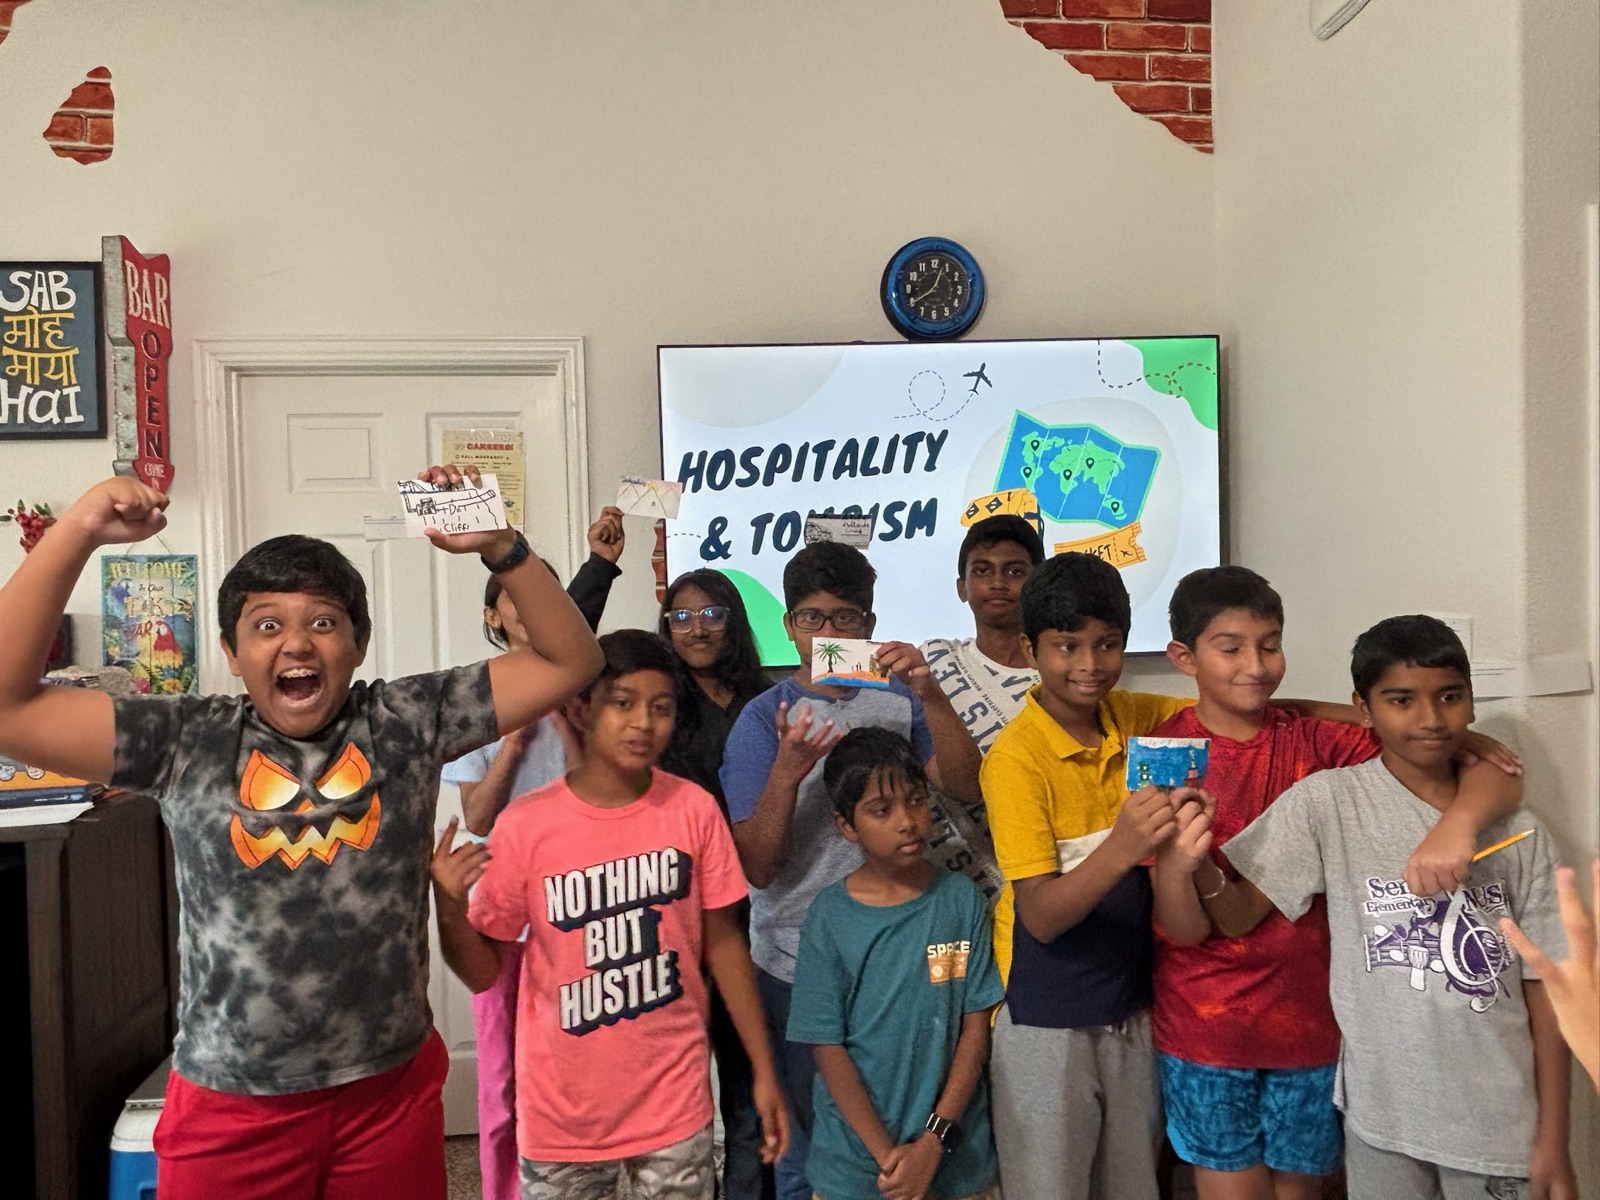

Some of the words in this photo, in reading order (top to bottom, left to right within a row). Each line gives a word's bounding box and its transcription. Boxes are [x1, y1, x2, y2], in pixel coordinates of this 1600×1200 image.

[919, 263, 926, 272] 11
[931, 259, 939, 269] 12
[945, 263, 949, 272] 1
[909, 272, 917, 281] 10
[954, 272, 959, 281] 2
[0, 270, 77, 311] SAB
[125, 259, 170, 330] BAR
[906, 284, 911, 294] 9
[957, 285, 962, 295] 3
[953, 298, 959, 308] 4
[920, 307, 925, 316] 7
[931, 310, 936, 319] 6
[944, 307, 949, 316] 5
[3, 305, 75, 349] मोह
[2, 346, 80, 386] माया
[141, 330, 163, 460] OPEN
[677, 429, 949, 493] HOSPITALITY
[699, 516, 732, 561] &
[750, 497, 938, 555] TOISM
[110, 561, 187, 578] WELCOME
[544, 846, 687, 926] NOTHING
[584, 907, 646, 968] BUT
[559, 951, 673, 1031] HUSTLE
